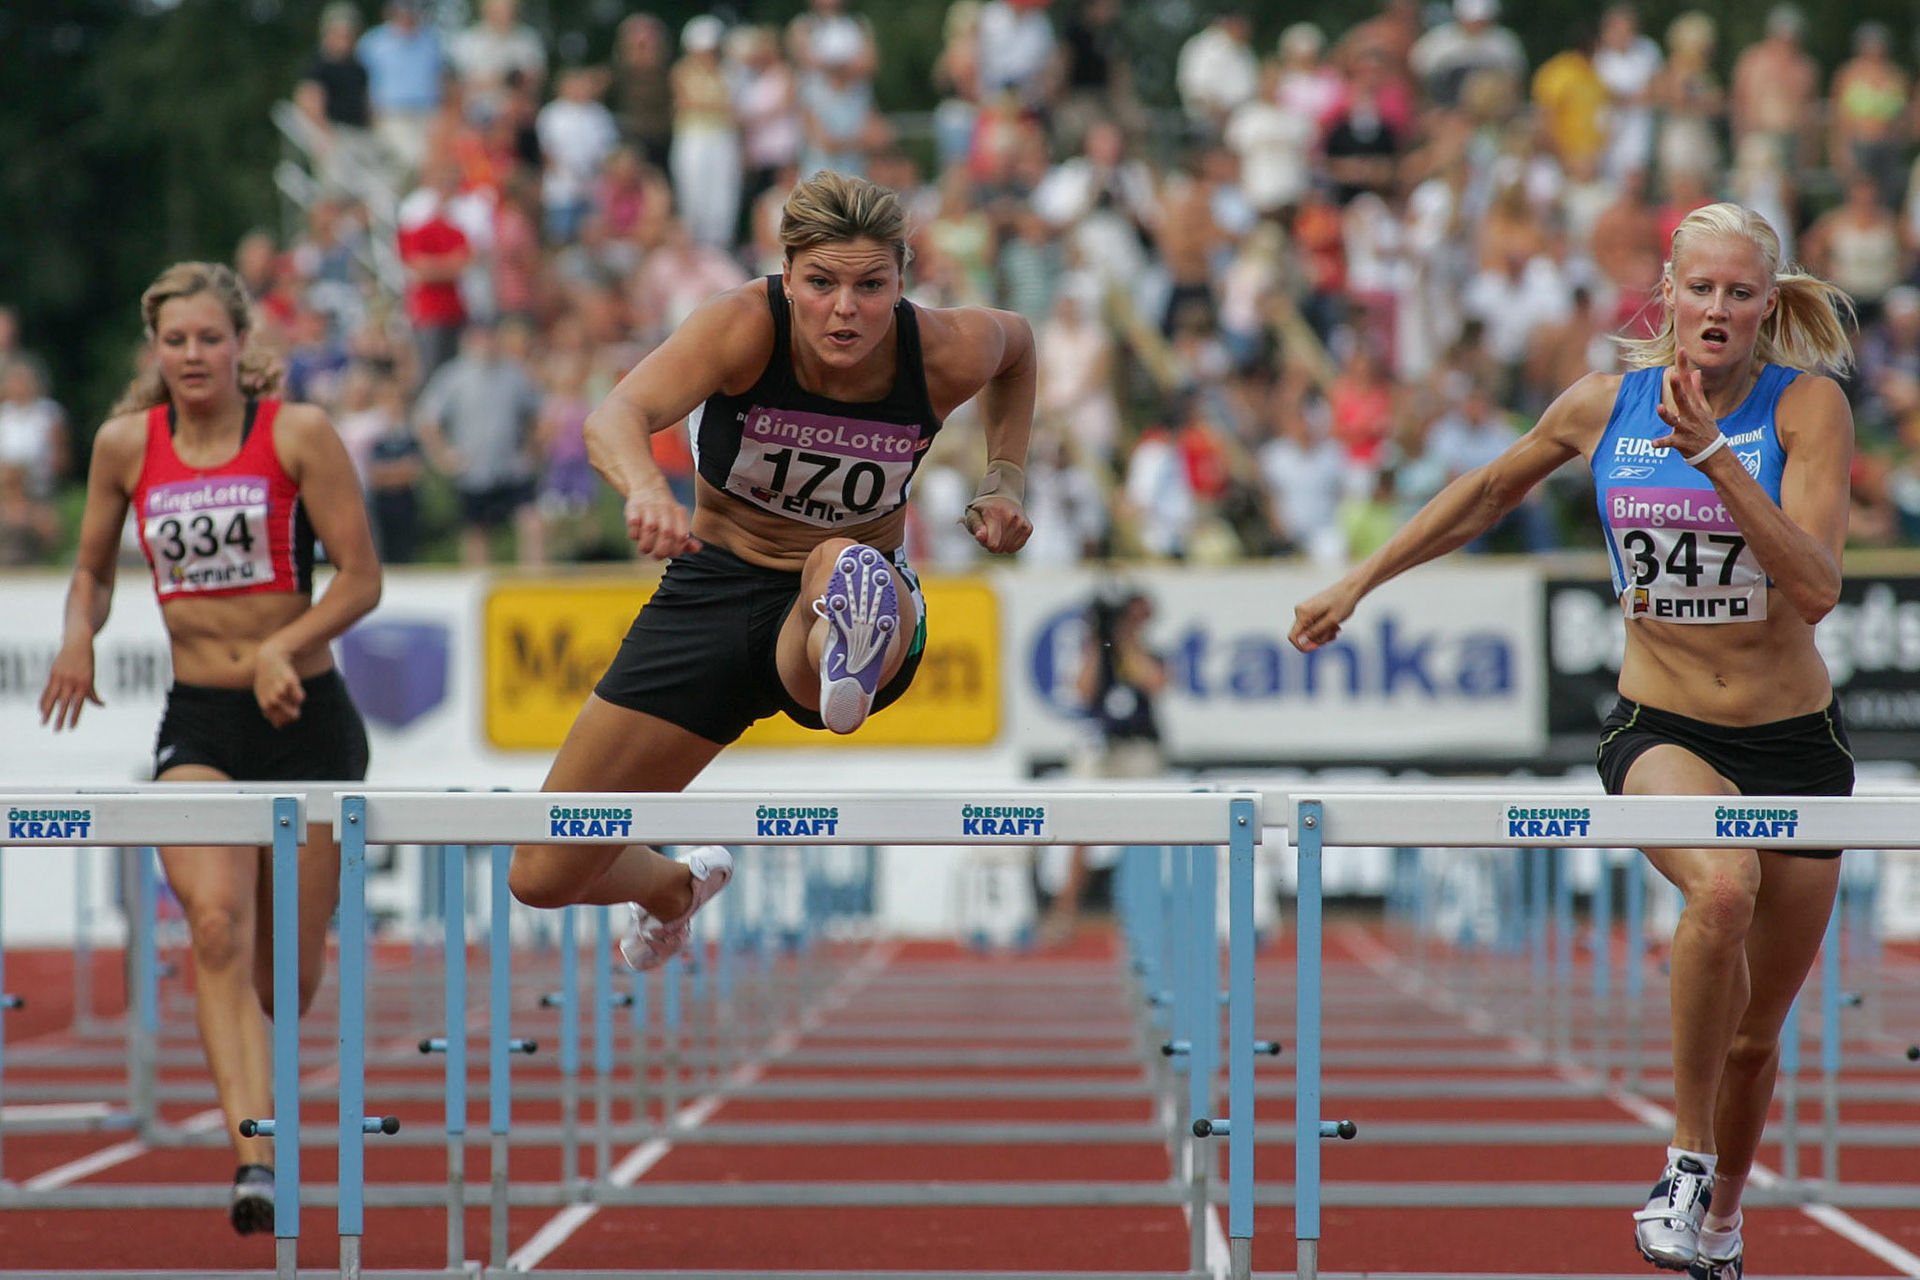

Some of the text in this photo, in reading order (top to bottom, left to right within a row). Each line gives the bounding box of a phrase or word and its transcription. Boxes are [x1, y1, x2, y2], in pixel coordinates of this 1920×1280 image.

[754, 414, 911, 454] BingoLotto
[1613, 456, 1663, 465] Accident
[763, 448, 886, 512] 170
[149, 484, 266, 512] BingoLotto
[1613, 496, 1734, 527] BingoLot
[159, 512, 256, 562] 334
[1623, 530, 1748, 587] 347
[1655, 597, 1749, 618] eniro
[8, 808, 91, 821] ÖRESUNDS
[550, 806, 632, 819] ÖRESUNDS
[756, 805, 838, 819] ÖRESUNDS
[962, 804, 1044, 818] ÖRESUNDS
[1508, 806, 1590, 820] ÖRESUNDS
[1715, 806, 1798, 820] ÖRESUNDS
[9, 821, 91, 838] KRAFT
[551, 820, 632, 837] KRAFT
[757, 819, 838, 836] KRAFT
[963, 818, 1044, 835] KRAFT
[1509, 820, 1590, 837] KRAFT
[1716, 820, 1798, 838] KRAFT
